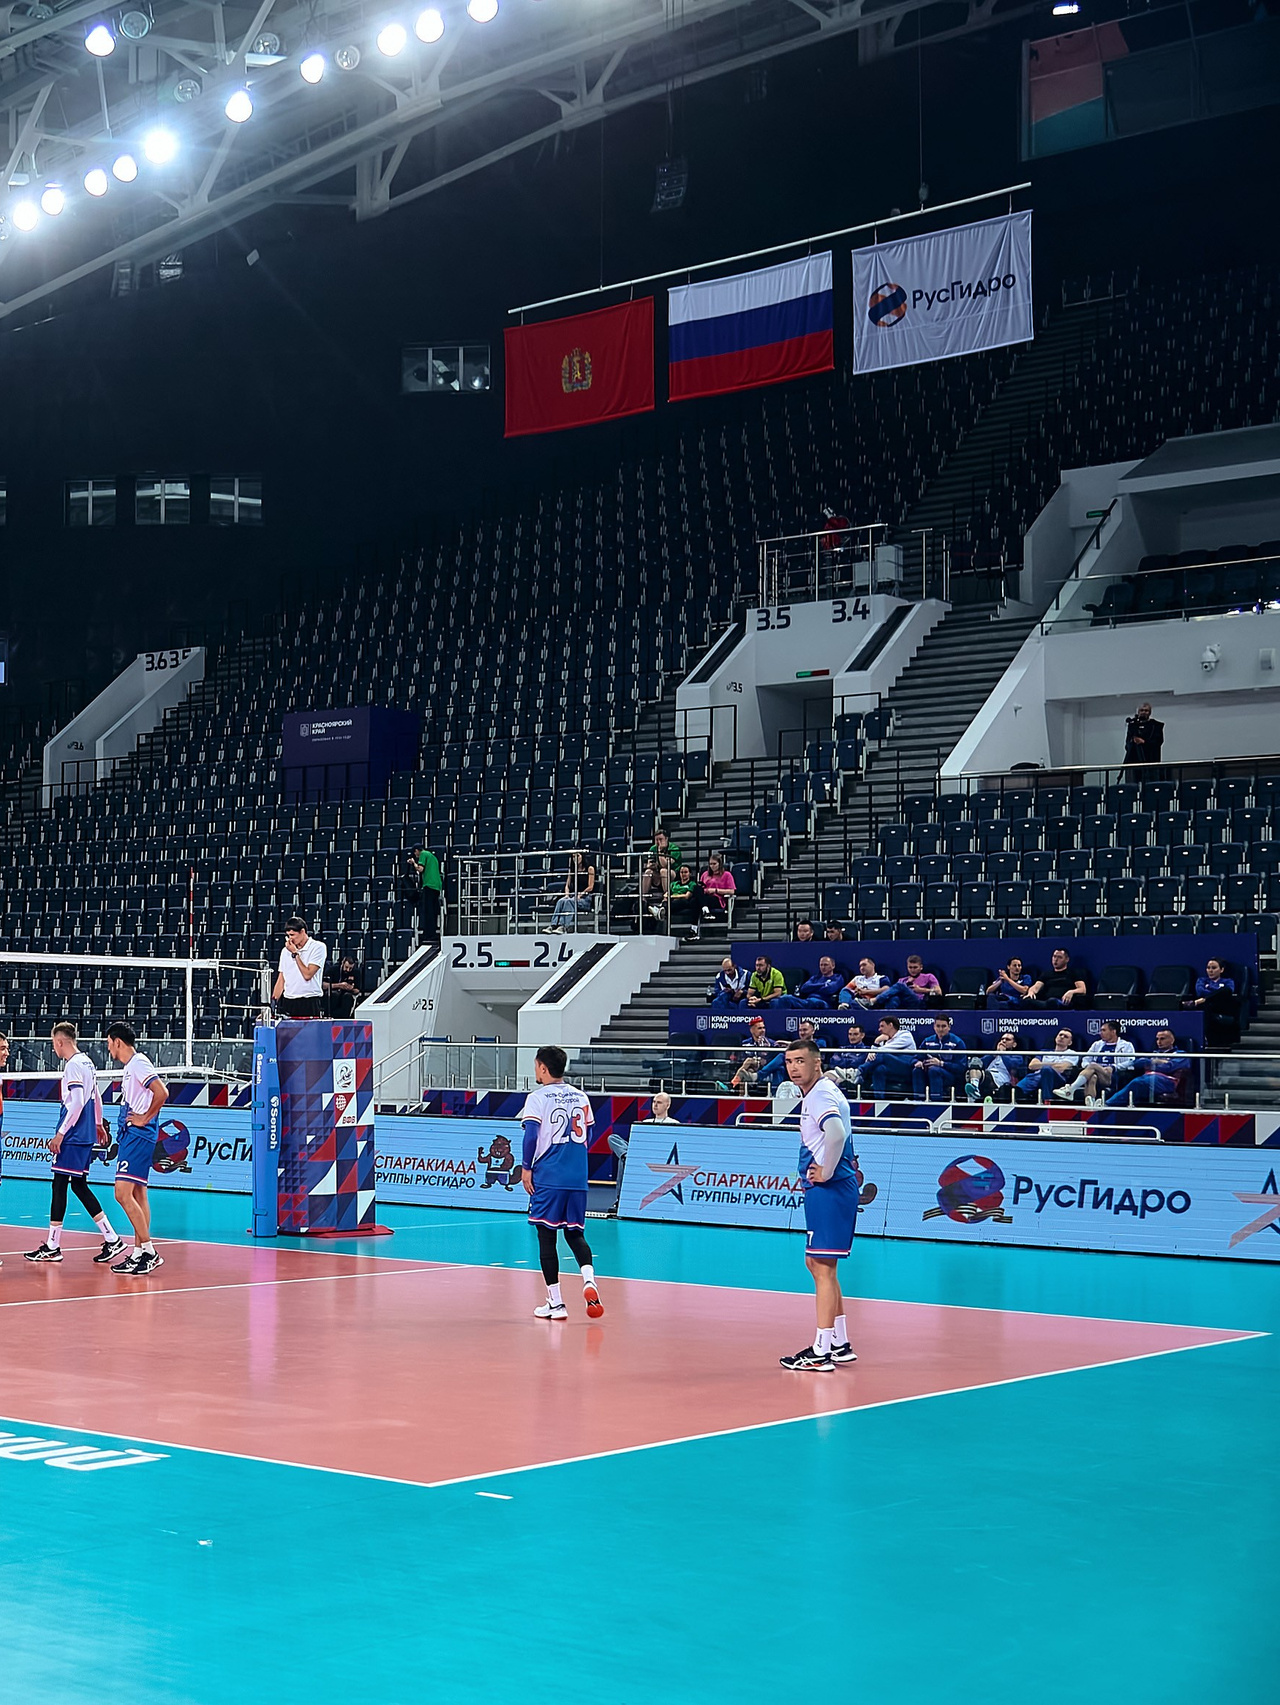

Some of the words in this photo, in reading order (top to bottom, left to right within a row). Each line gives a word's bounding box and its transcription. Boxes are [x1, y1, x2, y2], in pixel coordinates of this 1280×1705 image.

[912, 273, 1016, 311] РусГидро
[756, 606, 791, 632] 3.5
[831, 598, 870, 623] 3.4
[145, 652, 168, 671] 3.6
[732, 681, 743, 693] 3.5
[452, 941, 493, 968] 2.5
[533, 941, 574, 968] 2.4
[711, 1015, 762, 1024] КРАСНОЯРСК
[998, 1017, 1059, 1027] КРАСНОЯРСКИЙ
[998, 1026, 1019, 1034] КРАЙ
[550, 1106, 587, 1145] 23
[192, 1136, 253, 1165] РусГи
[374, 1155, 477, 1175] СПАРТАКИАДА
[415, 1174, 476, 1189] РУСГИДРО
[693, 1172, 805, 1194] СПАРТАКИАД
[691, 1190, 740, 1204] ГРУППЫ
[743, 1193, 805, 1209] РУСГИДР
[1012, 1175, 1192, 1219] РусГидро
